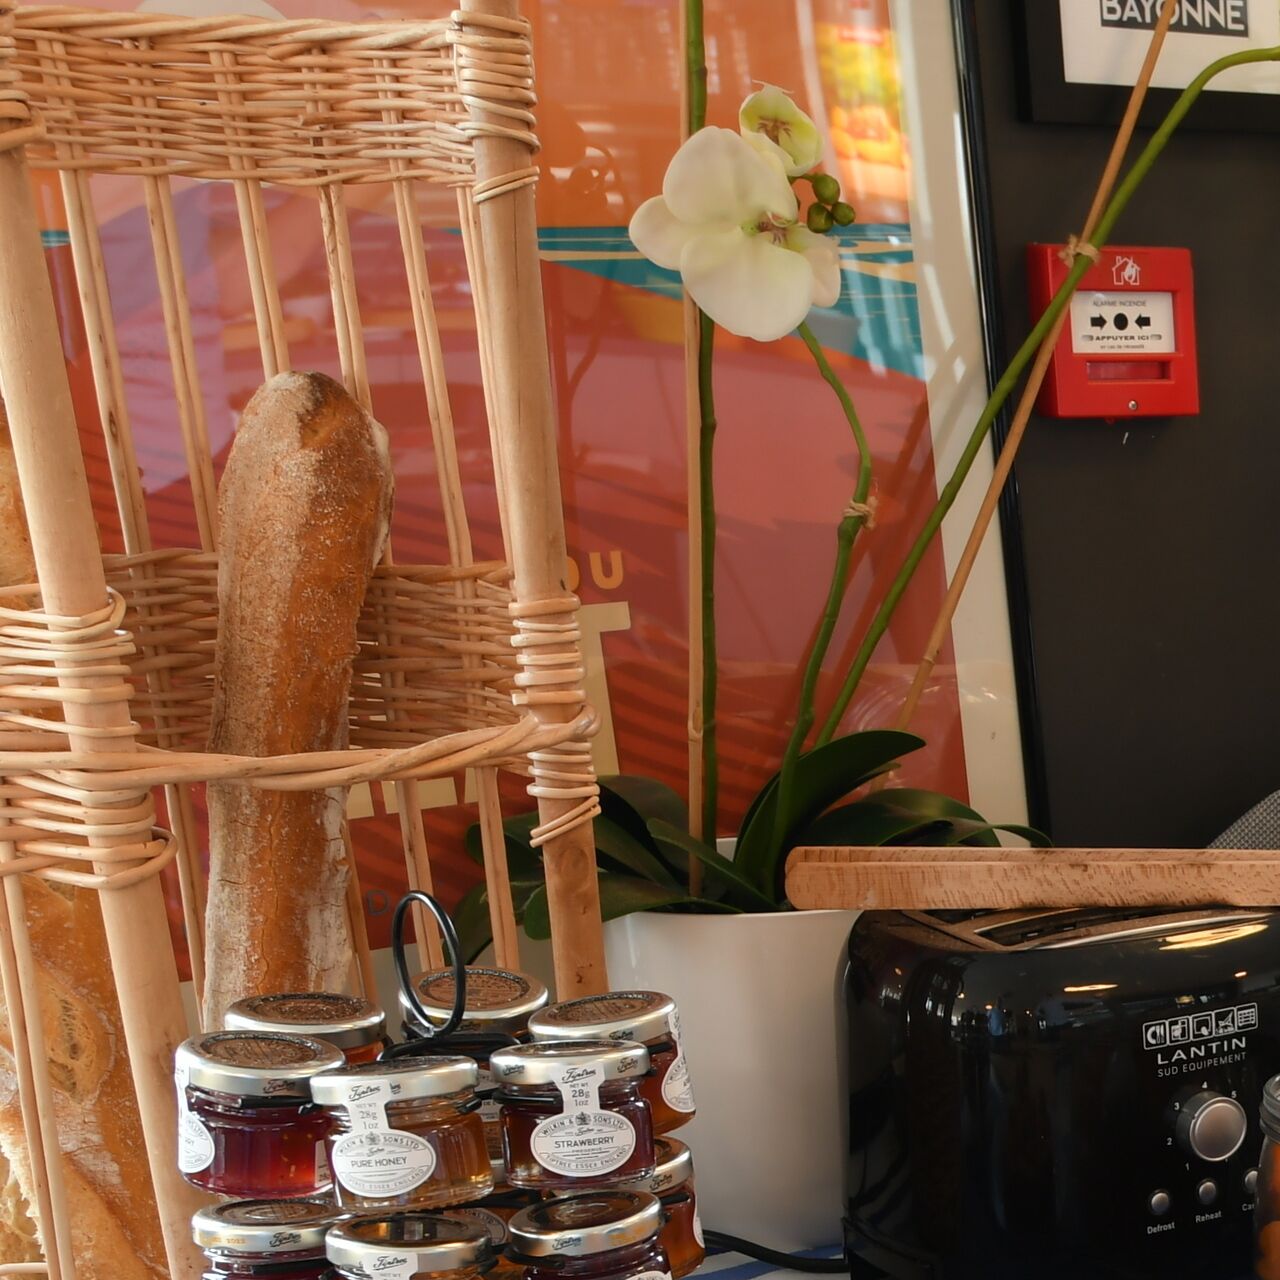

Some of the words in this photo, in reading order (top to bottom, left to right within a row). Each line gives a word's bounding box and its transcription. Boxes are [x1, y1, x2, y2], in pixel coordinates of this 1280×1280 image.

[1102, 0, 1245, 31] BAYONNE
[1158, 1037, 1246, 1065] LANTIN
[1158, 1066, 1179, 1077] SUD
[1182, 1052, 1246, 1073] EQUIPEMENT
[1202, 1081, 1208, 1089] 4
[572, 1089, 591, 1099] 28g
[574, 1099, 590, 1107] 1oz
[1174, 1102, 1180, 1110] 3
[359, 1110, 378, 1120] 28g
[593, 1115, 611, 1124] SONS
[383, 1136, 404, 1145] SONS
[554, 1136, 615, 1149] STRAWBERRY
[1167, 1137, 1173, 1145] 2
[351, 1159, 374, 1168] PURE
[374, 1156, 408, 1167] HONEY
[1185, 1163, 1190, 1171] 1
[1195, 1211, 1222, 1223] Reheat
[1147, 1221, 1175, 1234] Defrost
